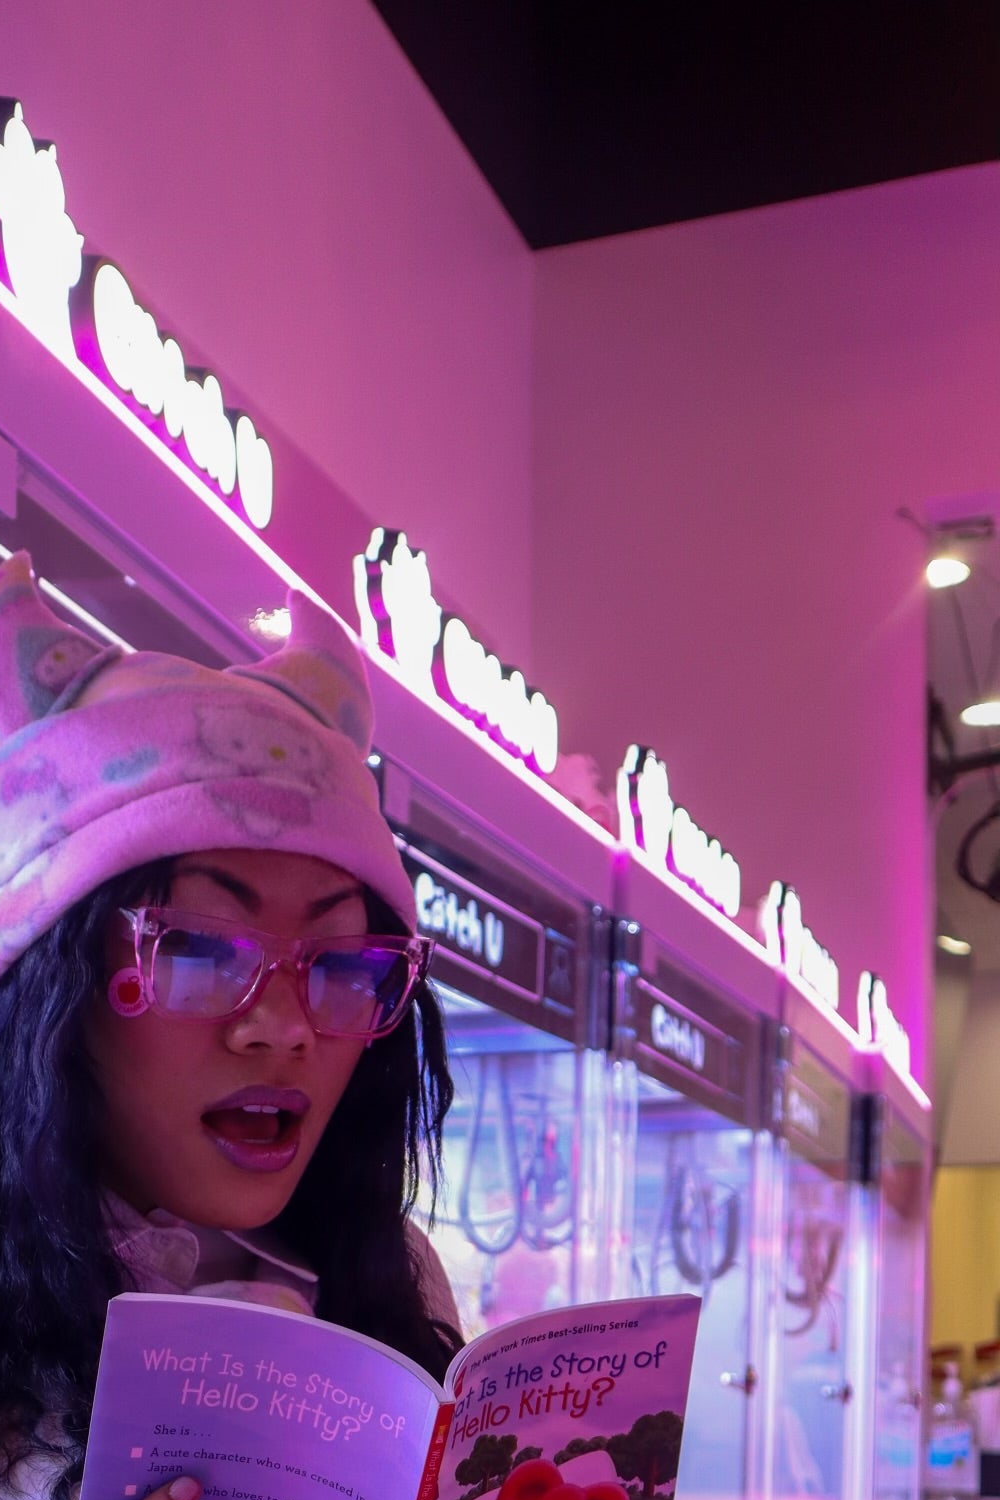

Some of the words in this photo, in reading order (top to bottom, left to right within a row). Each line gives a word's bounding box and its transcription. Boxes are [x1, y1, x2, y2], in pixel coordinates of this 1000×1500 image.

[482, 1349, 499, 1364] New
[500, 1341, 518, 1354] York
[521, 1333, 546, 1346] Times
[548, 1322, 606, 1339] Best-Selling
[609, 1318, 639, 1331] Series
[143, 1348, 212, 1373] What
[218, 1353, 245, 1377] Is
[255, 1359, 298, 1388] the
[305, 1373, 374, 1424] Story
[380, 1412, 406, 1438] of
[454, 1389, 475, 1418] at
[479, 1376, 497, 1402] Is
[505, 1363, 543, 1389] the
[551, 1349, 626, 1378] Story
[634, 1340, 668, 1369] of
[153, 1425, 177, 1436] She
[180, 1425, 190, 1436] is
[180, 1378, 259, 1412] Hello
[269, 1389, 361, 1442] Kitty?
[452, 1402, 510, 1448] Hello
[518, 1376, 615, 1419] Kitty?
[147, 1462, 183, 1475] Japan
[150, 1448, 159, 1457] A
[163, 1448, 190, 1458] cute
[193, 1449, 252, 1464] character
[256, 1457, 281, 1470] who
[285, 1464, 307, 1478] was
[310, 1473, 353, 1497] created
[431, 1450, 441, 1472] What
[203, 1486, 228, 1498] who
[421, 1483, 433, 1498] the
